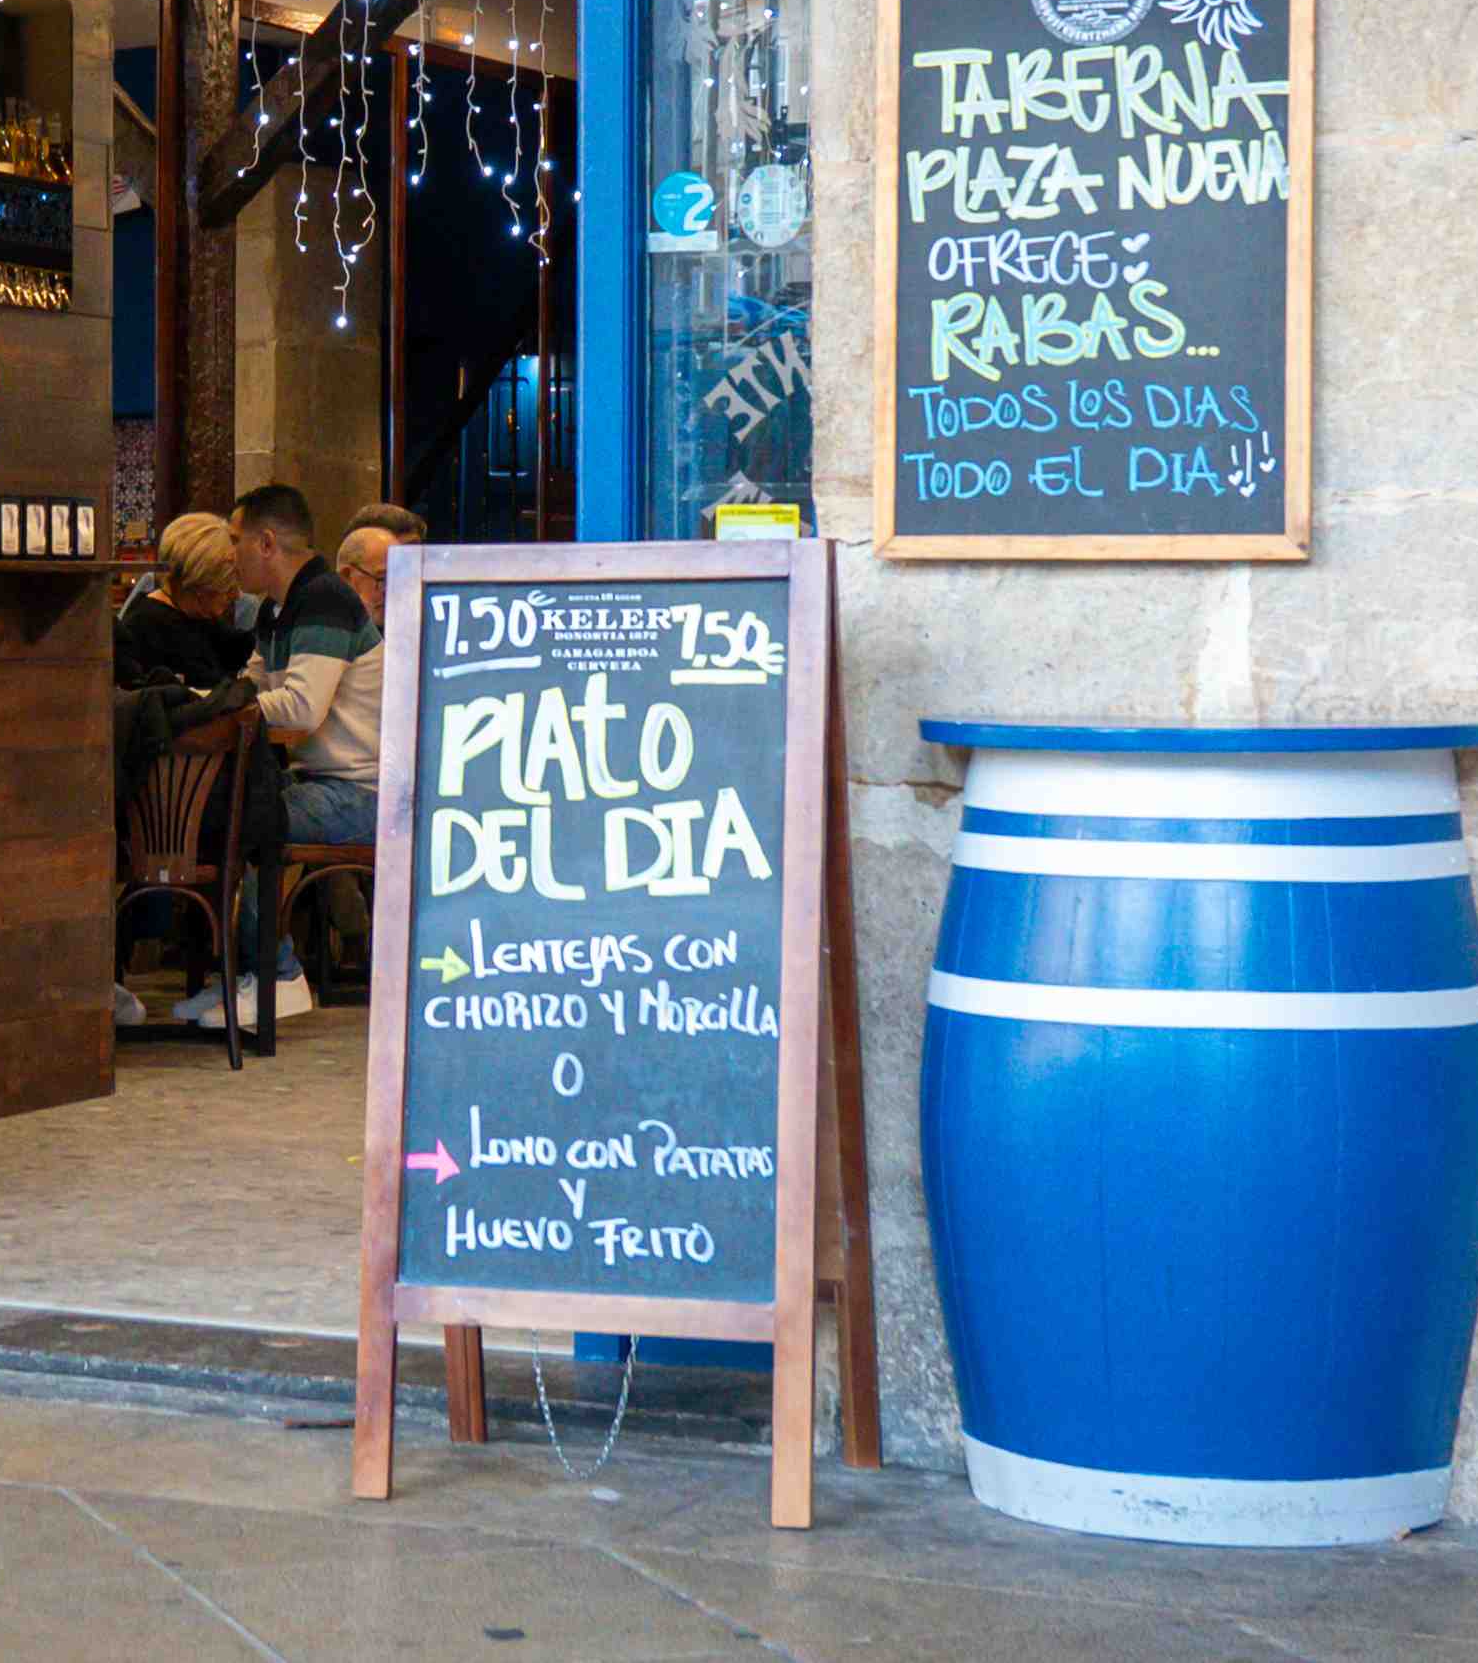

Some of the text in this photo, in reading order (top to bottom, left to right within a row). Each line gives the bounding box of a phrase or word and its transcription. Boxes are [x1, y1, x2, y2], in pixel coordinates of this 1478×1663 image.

[913, 41, 1289, 138] TABERNA
[906, 130, 1289, 223] PLAZA NUEVA
[683, 183, 715, 231] 2
[931, 280, 1220, 381] RABAS...
[908, 378, 1259, 439] TODOS LOS DIAS
[903, 451, 1012, 501] TODO
[1029, 446, 1104, 496] EL
[541, 608, 672, 630] KELER
[551, 648, 659, 658] GARAGARDOA
[567, 661, 642, 671] CERVEZA
[431, 787, 773, 900] DEL DIA
[469, 918, 738, 987] LENTEJAS CON
[423, 991, 588, 1031] CHORIZO
[600, 990, 626, 1036] Y
[551, 1052, 584, 1097] O
[469, 1105, 773, 1179] LOMO CON PATATAS
[559, 1178, 586, 1220] Y
[446, 1205, 715, 1266] HUEVO FRITO
